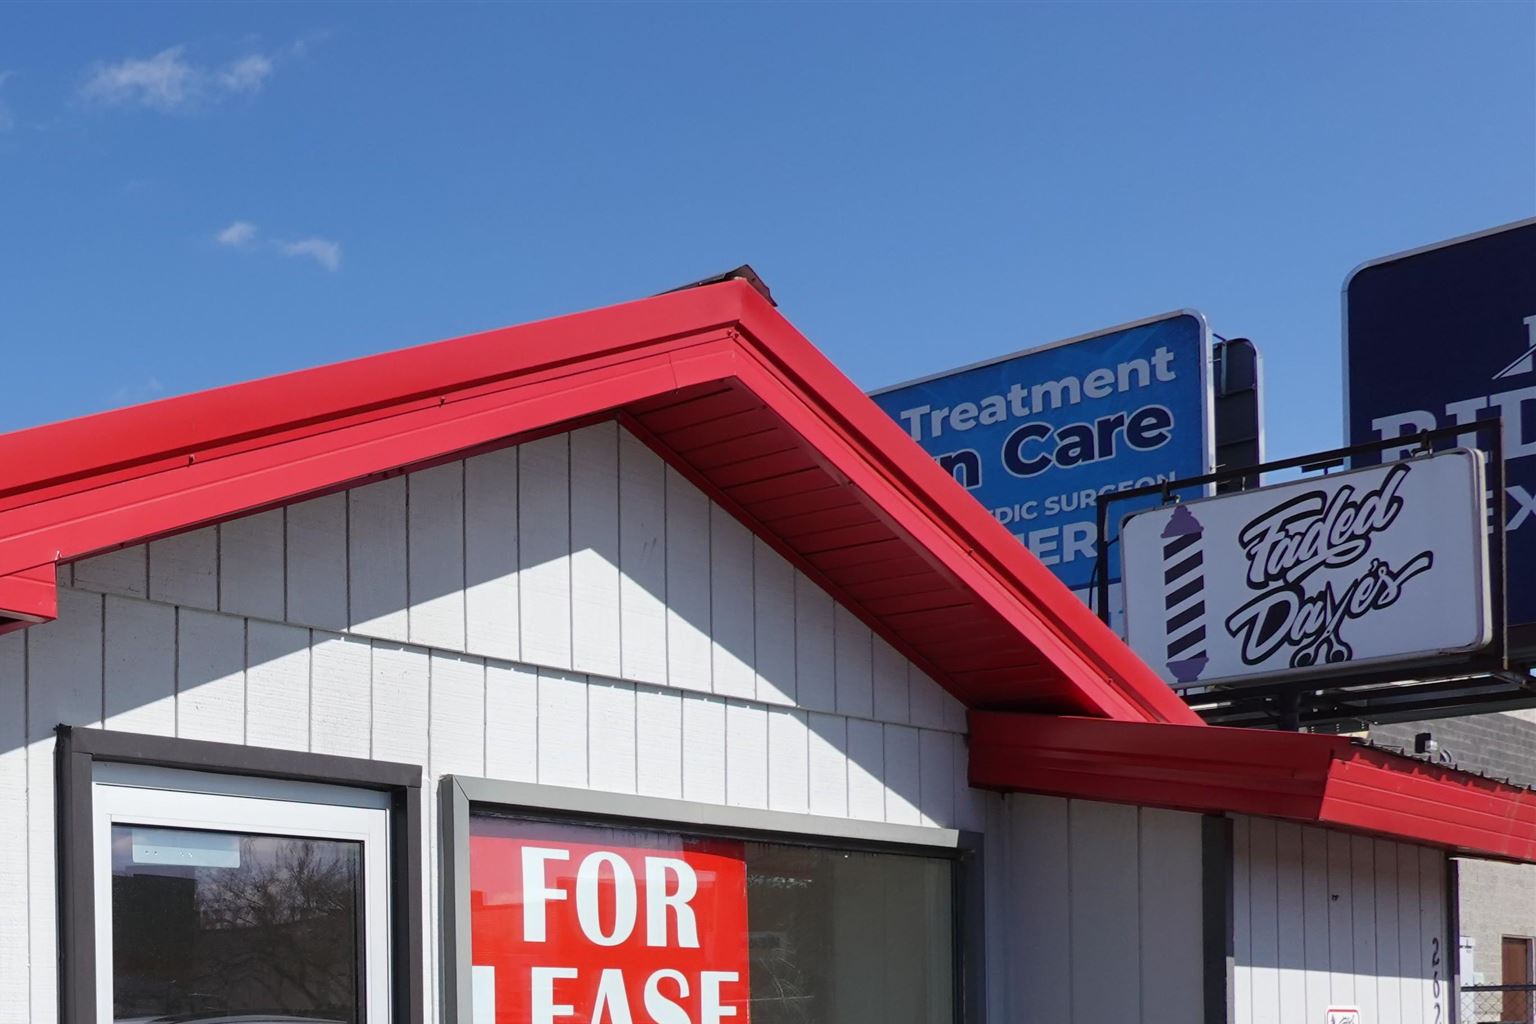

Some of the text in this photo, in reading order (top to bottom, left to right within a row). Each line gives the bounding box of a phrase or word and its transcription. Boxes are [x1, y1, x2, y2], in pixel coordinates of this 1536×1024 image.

[901, 346, 1177, 441] Treatment
[1001, 404, 1175, 478] Care
[988, 501, 1039, 525] DIC
[1238, 463, 1411, 590] Faded
[1225, 551, 1433, 667] Dave's
[520, 846, 700, 949] FOR
